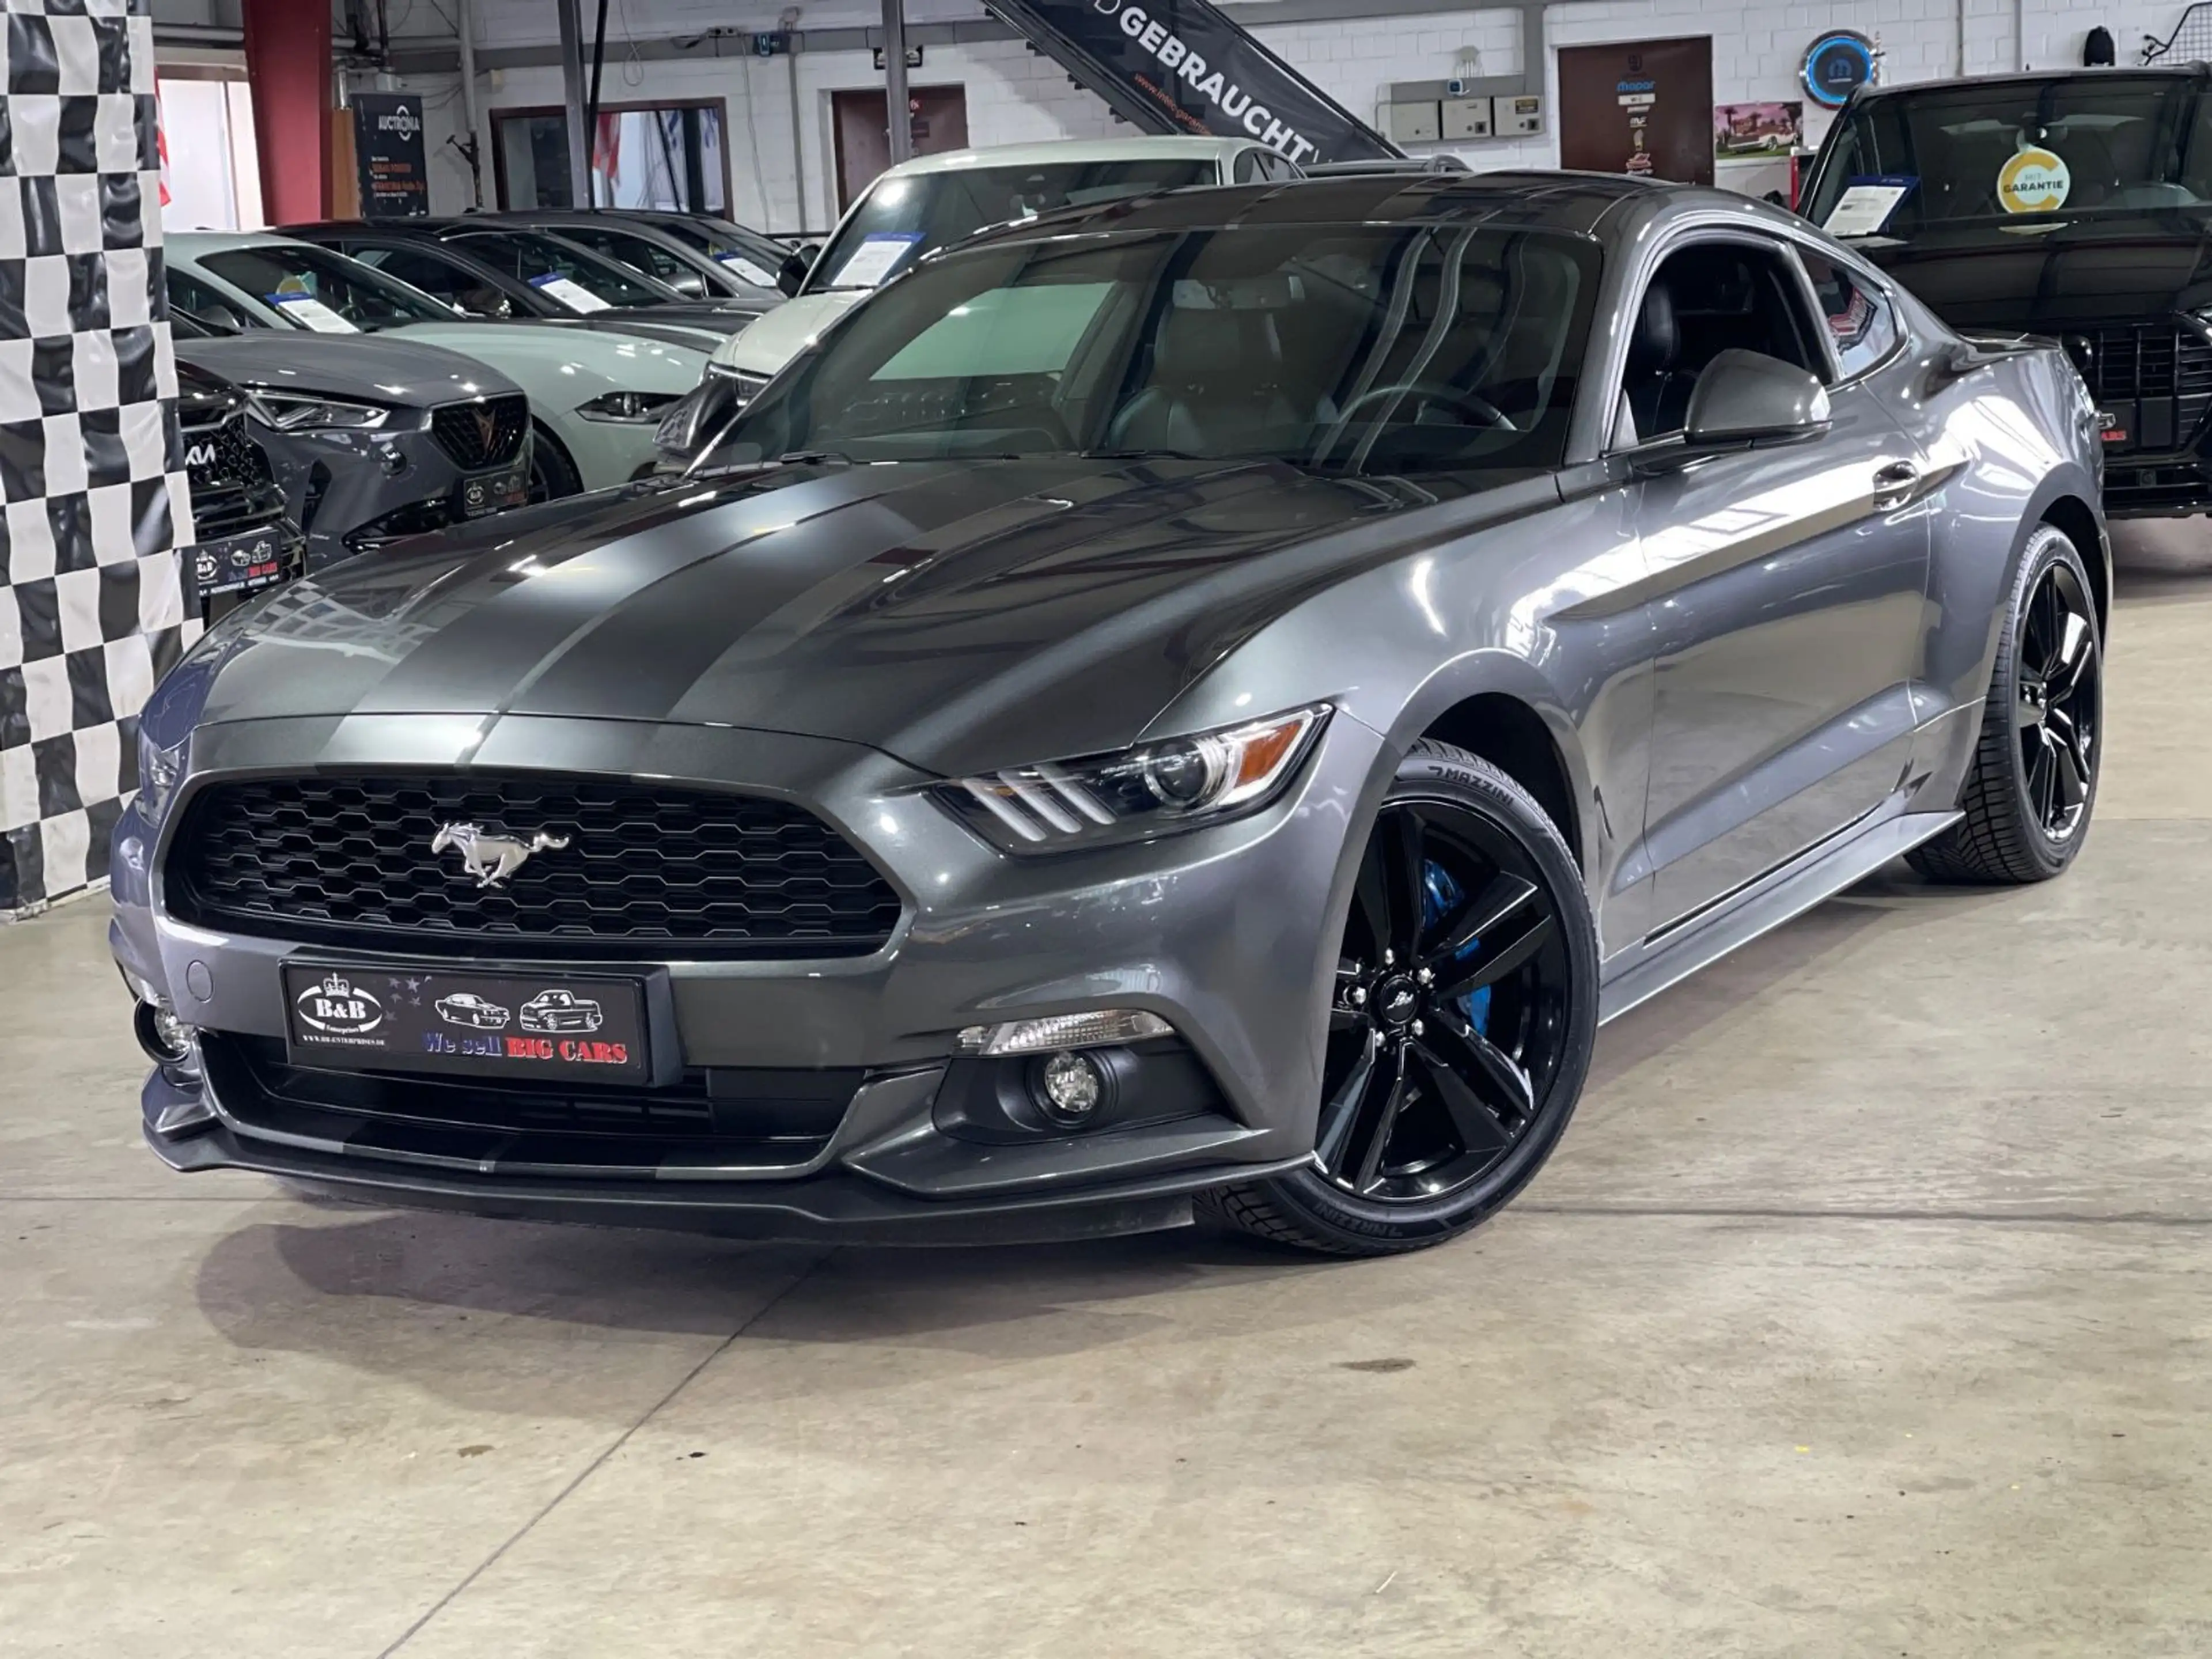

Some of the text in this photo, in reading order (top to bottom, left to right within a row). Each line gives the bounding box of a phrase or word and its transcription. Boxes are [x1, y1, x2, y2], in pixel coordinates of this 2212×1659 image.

[2003, 180, 2064, 193] GARANTIE
[1445, 767, 1514, 805] MAZZINI
[315, 998, 366, 1019] B&B
[423, 1032, 628, 1064] We sell BIG CARS
